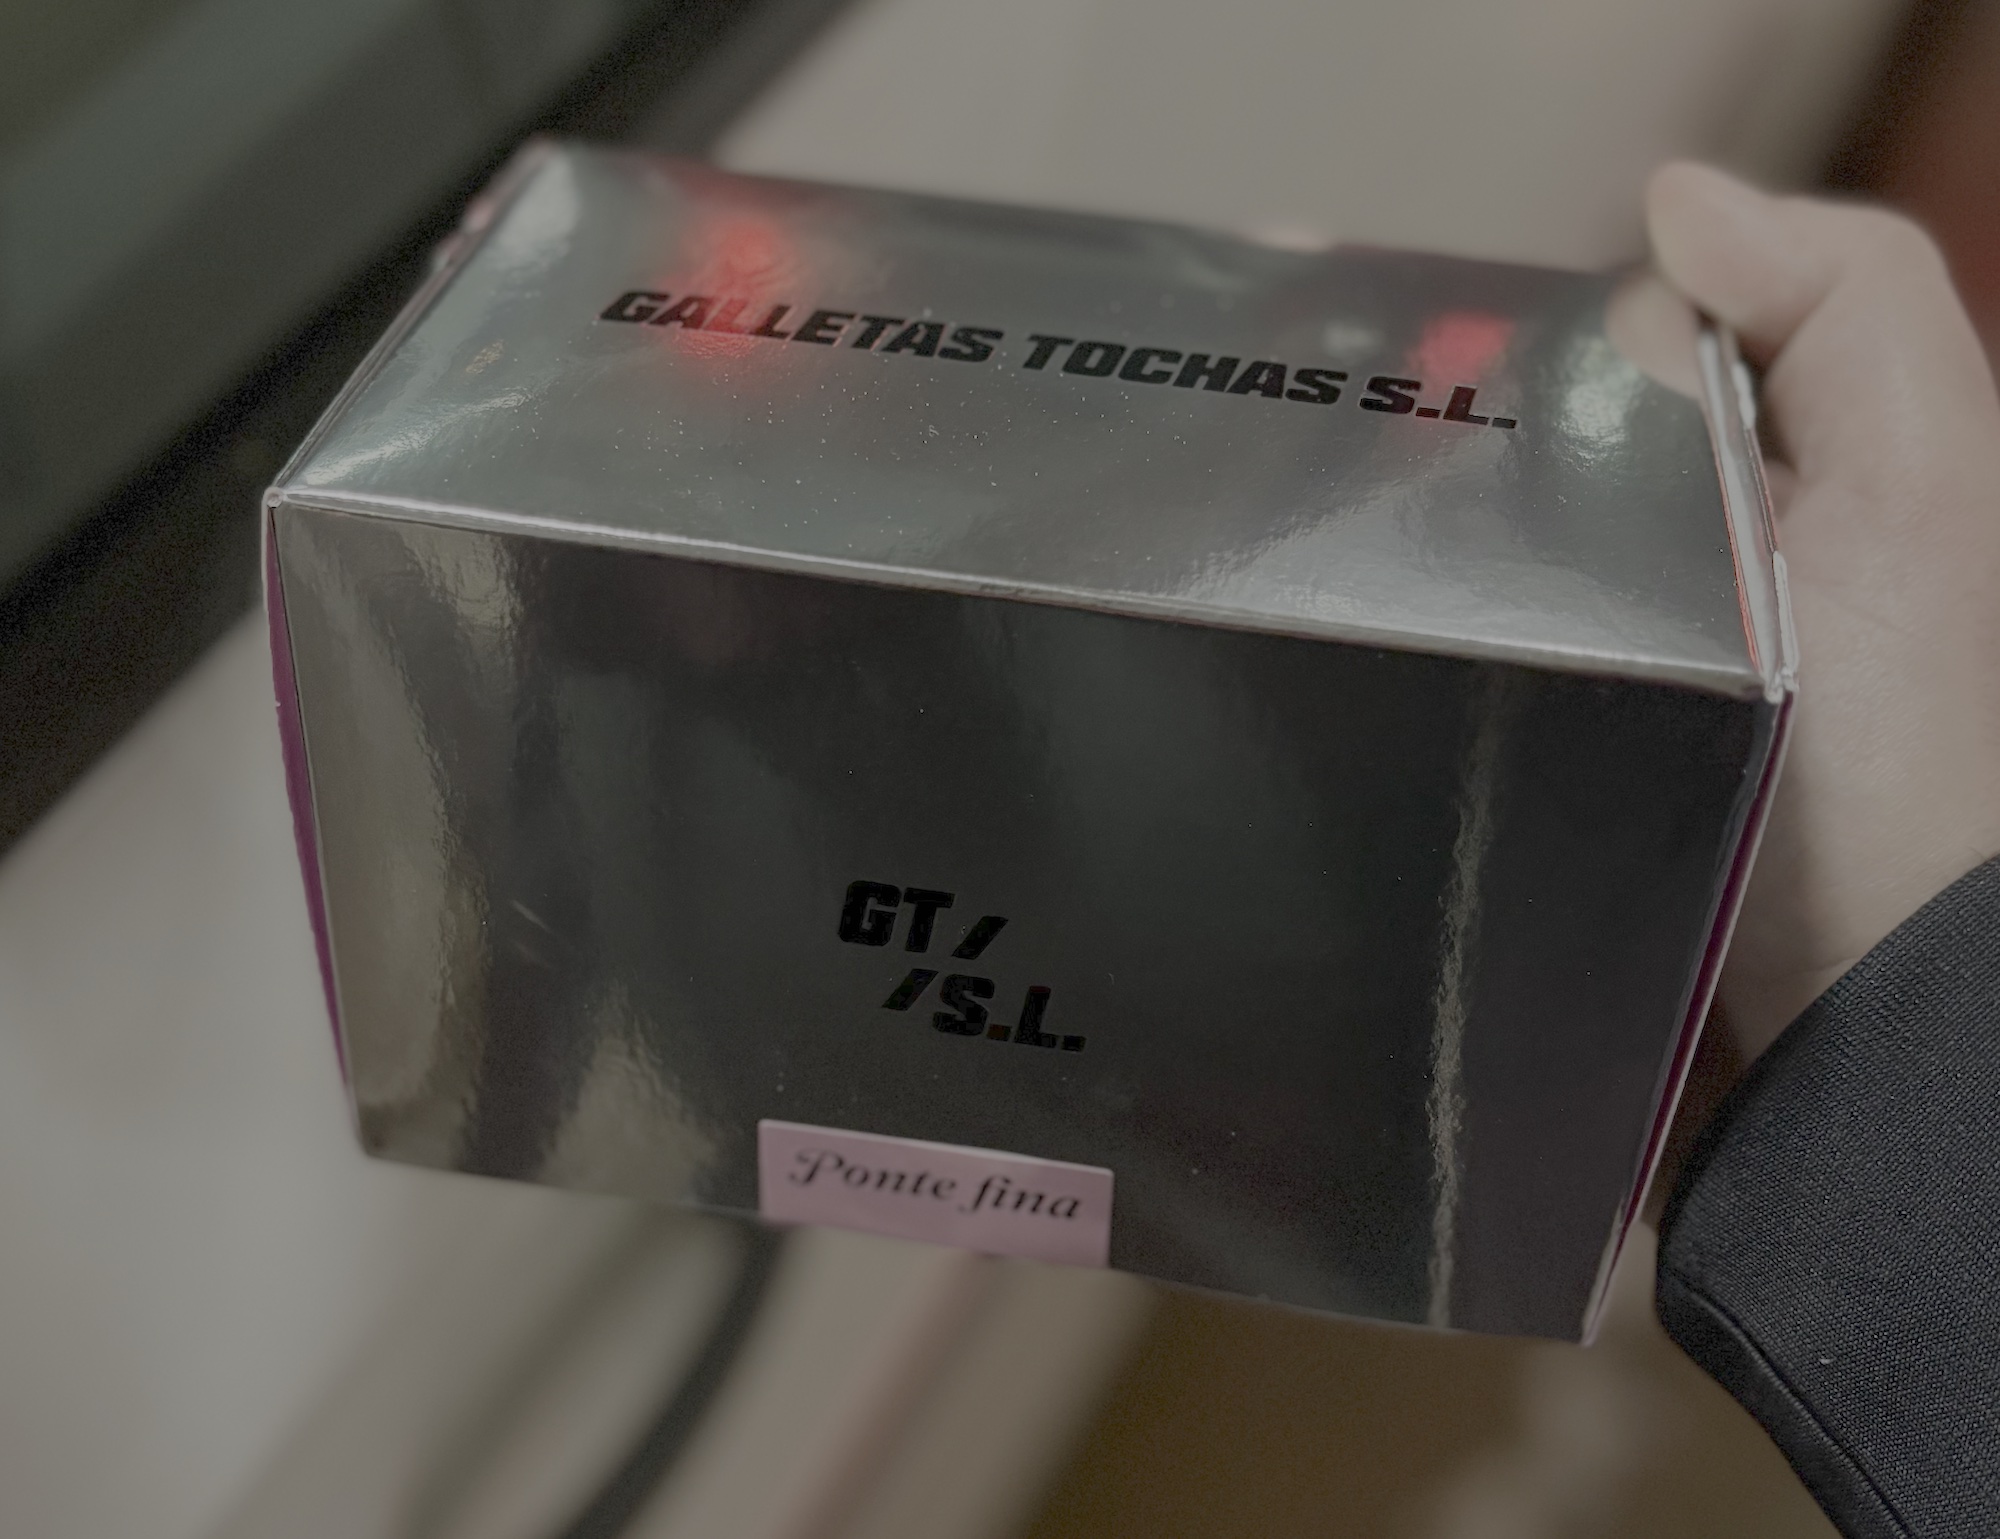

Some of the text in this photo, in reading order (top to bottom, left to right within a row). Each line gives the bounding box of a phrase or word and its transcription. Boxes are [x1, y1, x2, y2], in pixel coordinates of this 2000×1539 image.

[599, 289, 1517, 429] GALLETAS TOCHAS S.L.
[789, 1148, 1082, 1220] Ponte fina
